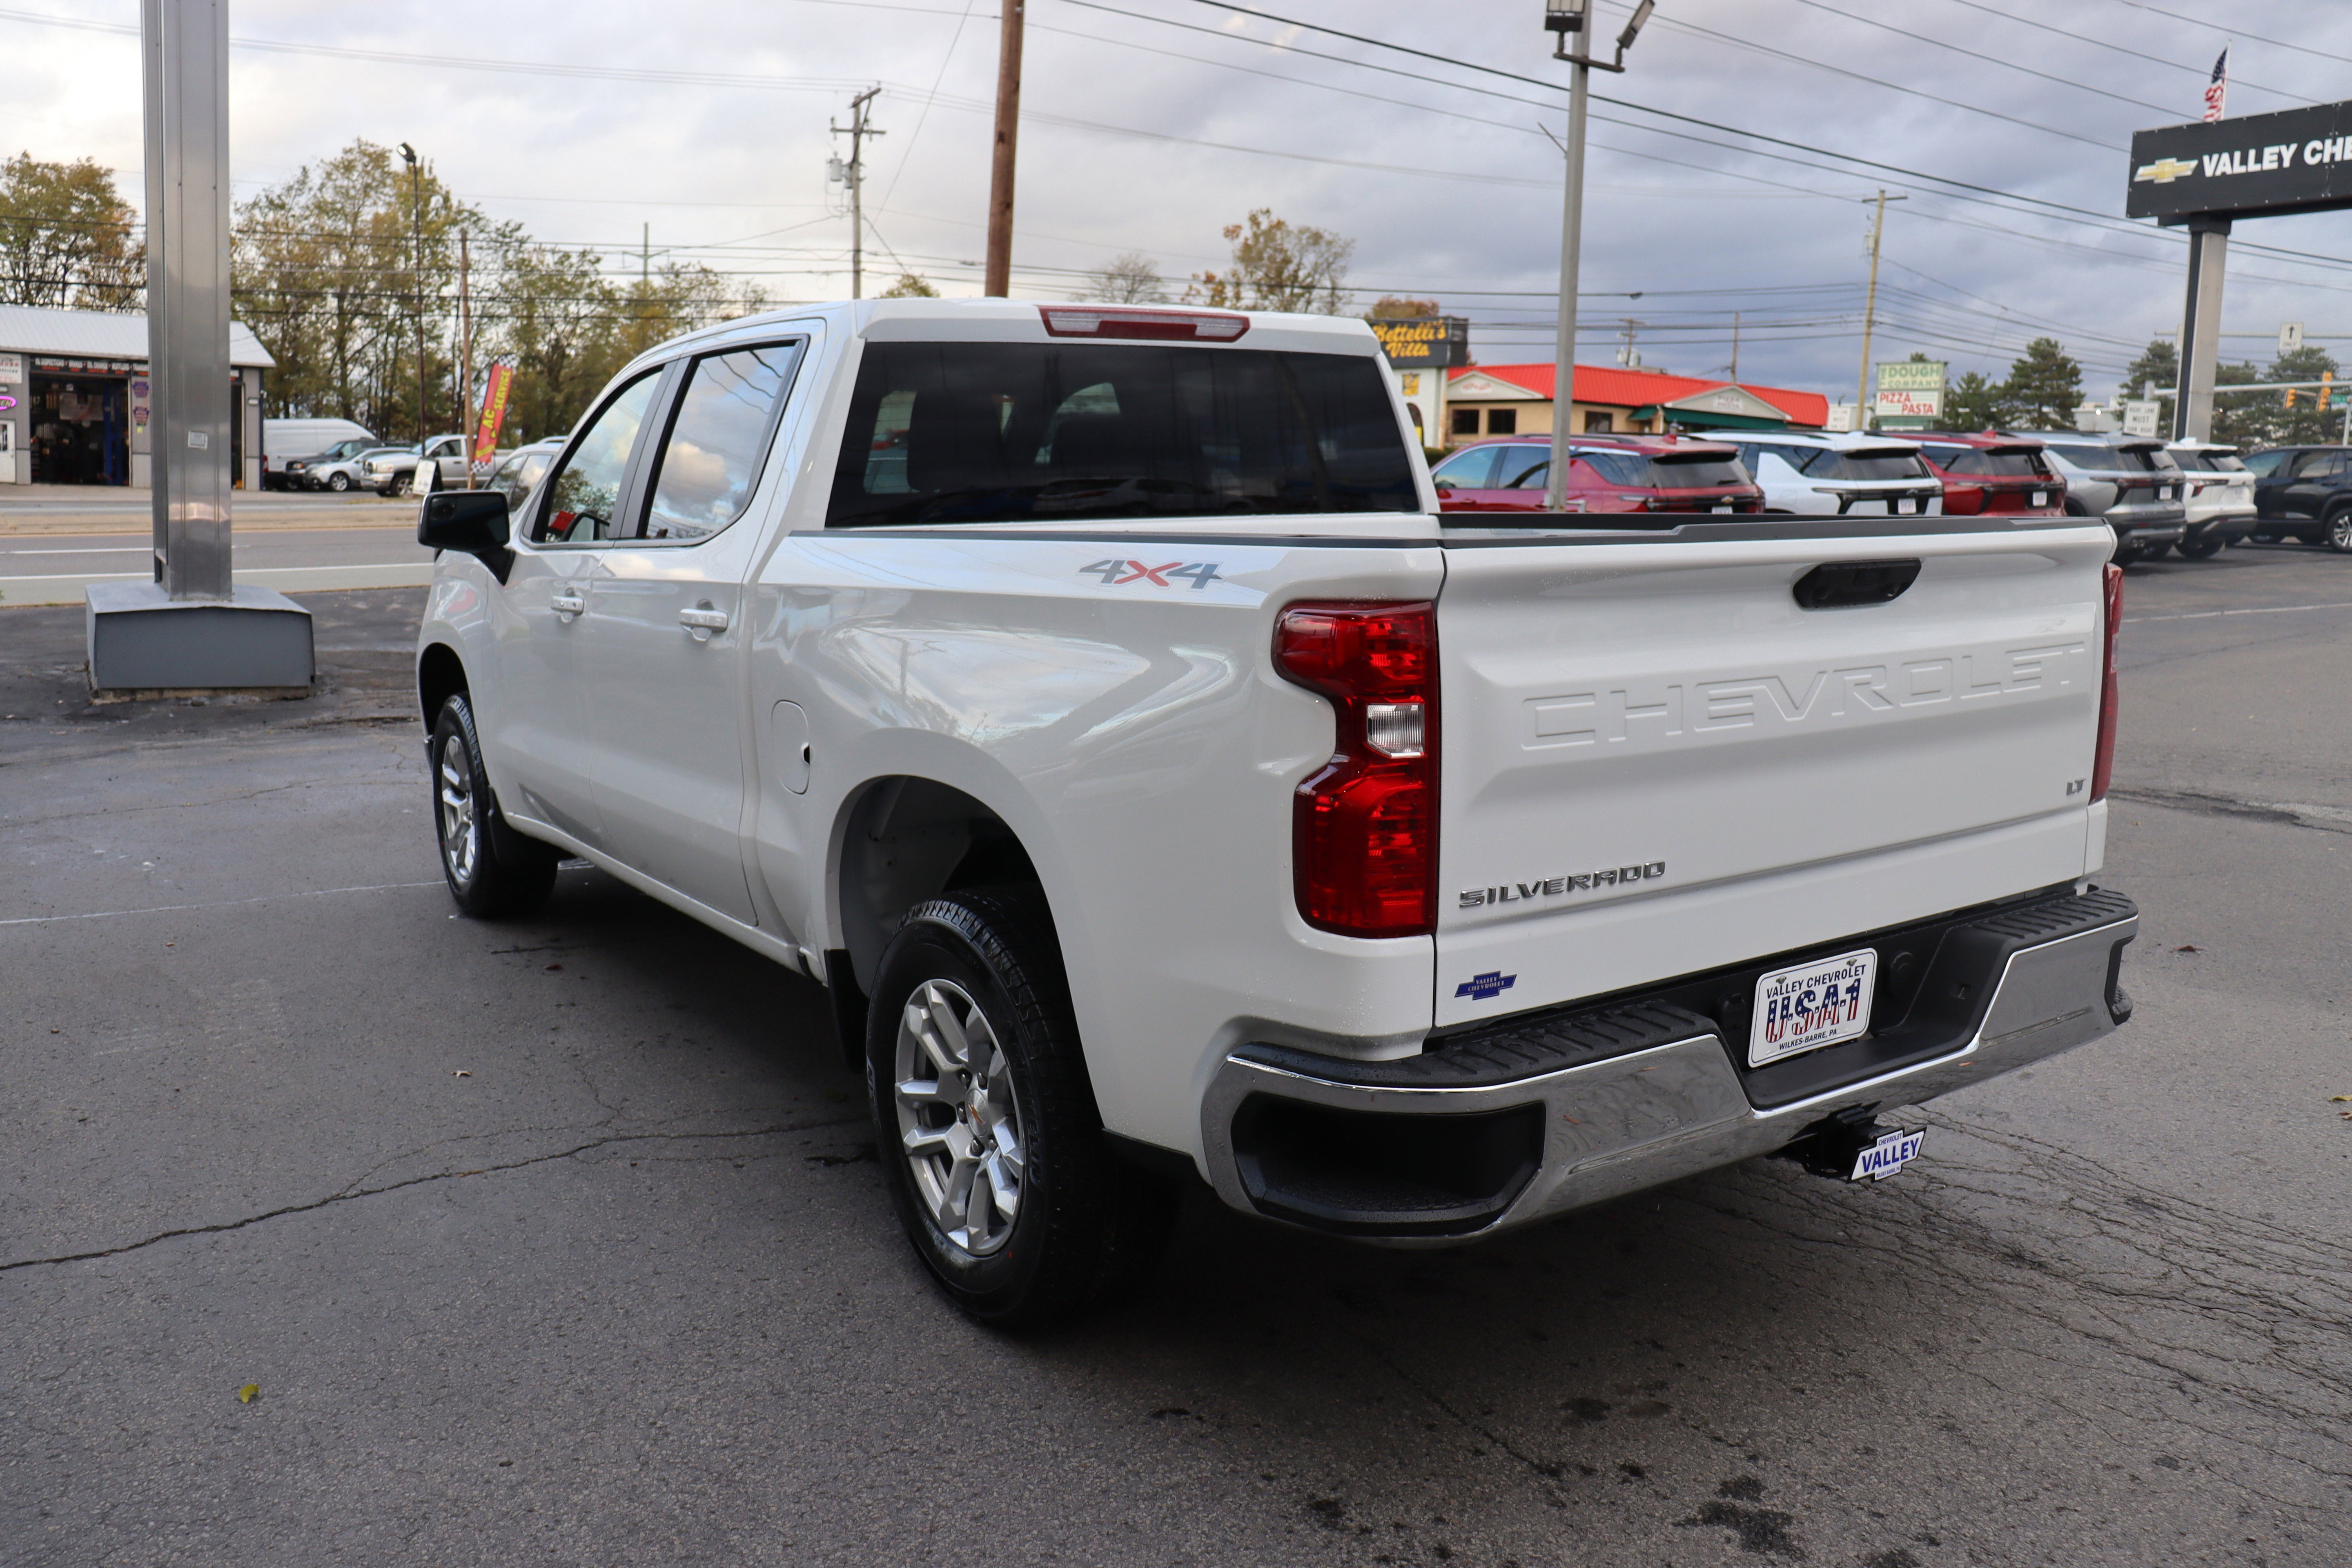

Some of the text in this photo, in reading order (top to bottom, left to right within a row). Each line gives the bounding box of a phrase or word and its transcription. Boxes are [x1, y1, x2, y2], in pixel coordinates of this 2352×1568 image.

[2202, 143, 2298, 177] VALLEY
[1385, 342, 1430, 359] Villa
[1889, 367, 1940, 378] DOUGH
[493, 369, 511, 411] SERVICE
[1880, 392, 1911, 403] PIZZA
[1902, 403, 1934, 414] PASTA
[482, 409, 495, 429] AC
[1522, 641, 2085, 751] CHEVROLET
[2066, 777, 2086, 796] LT
[1459, 860, 1666, 908] SILVERADO
[1468, 980, 1505, 992] CHEVROLET
[1476, 976, 1497, 985] VALLEY
[1766, 964, 1866, 999] VALLEY CHEVROLET
[1779, 1031, 1828, 1050] WILKES-BARRE,
[1878, 1133, 1902, 1146] CHEVROLET
[1862, 1137, 1919, 1173] VALLEY
